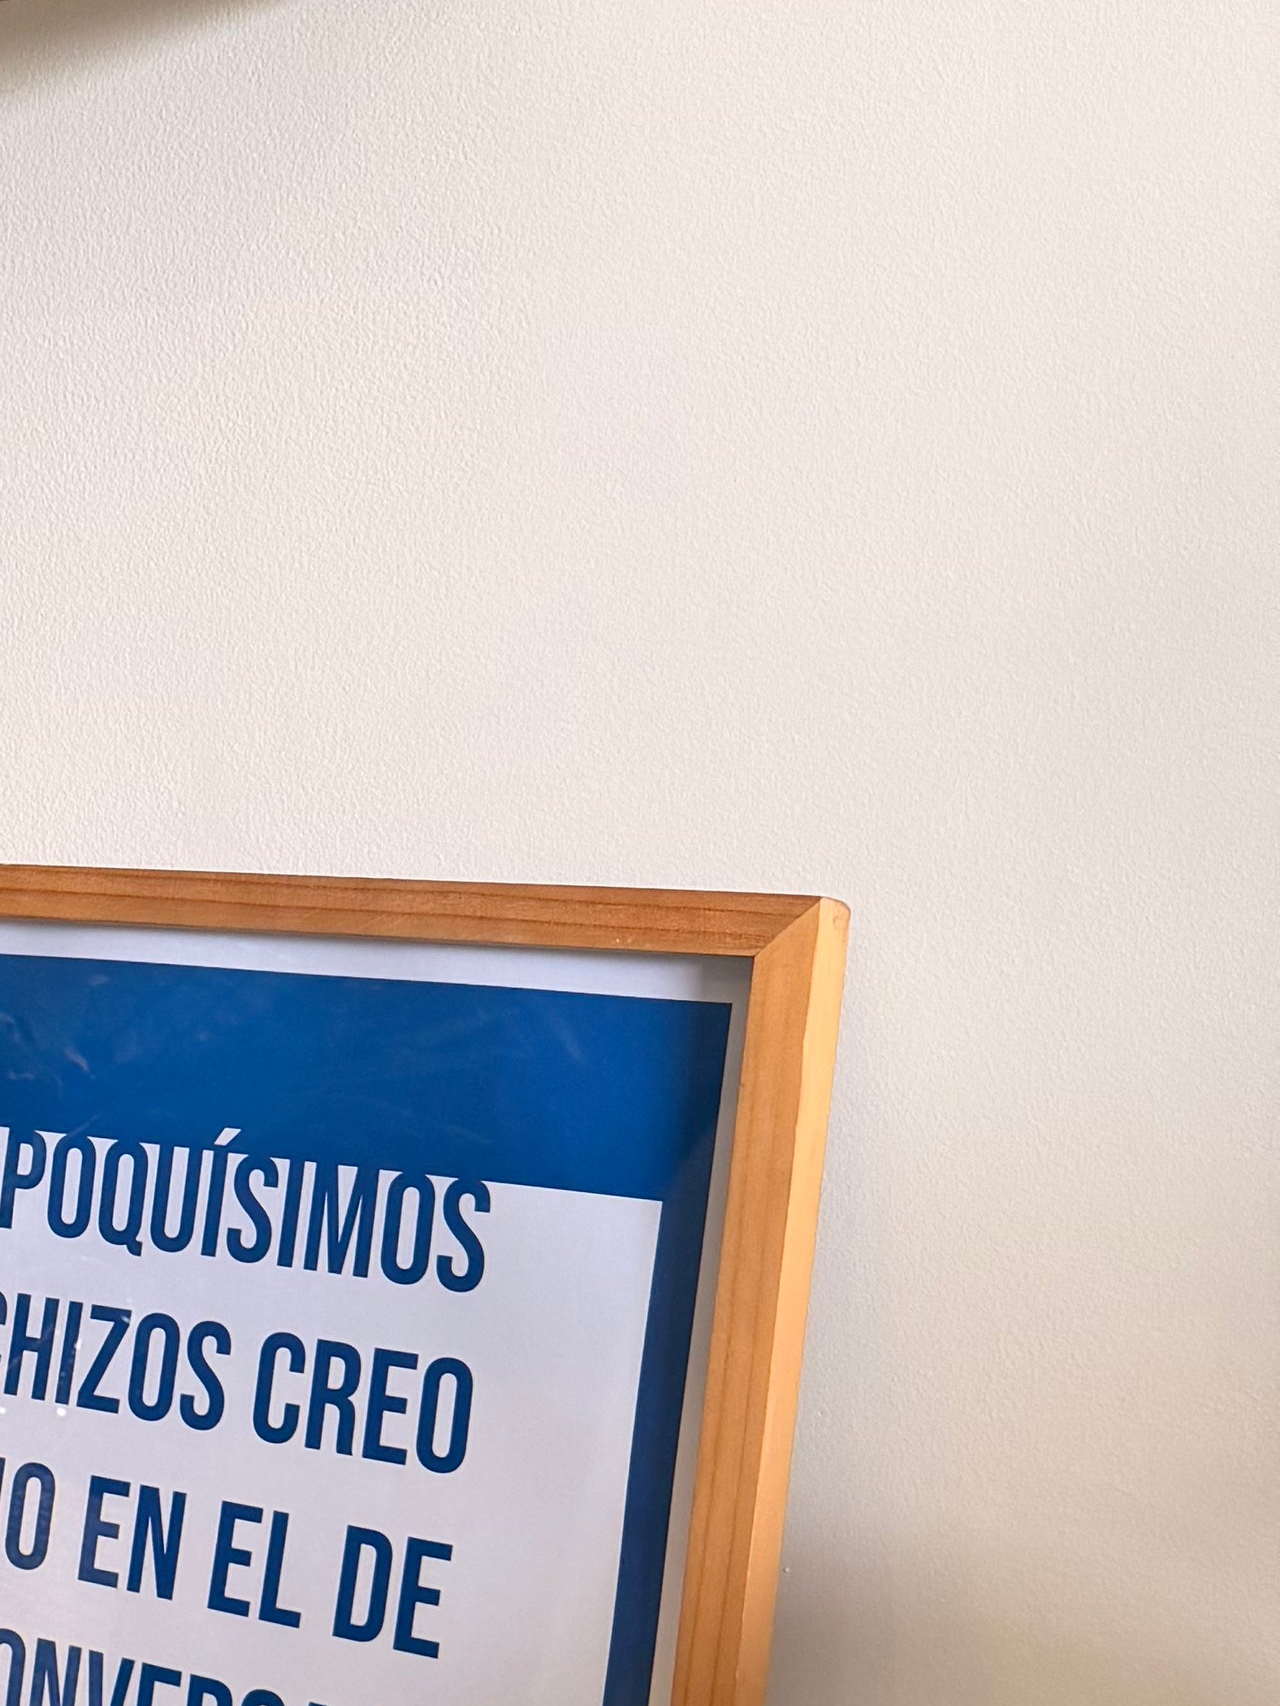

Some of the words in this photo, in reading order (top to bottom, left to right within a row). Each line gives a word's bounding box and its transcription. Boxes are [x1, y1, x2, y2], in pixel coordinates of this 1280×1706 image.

[252, 1331, 474, 1474] CREO
[77, 1474, 188, 1601] EN
[207, 1496, 302, 1629] EL
[332, 1524, 454, 1660] DE
